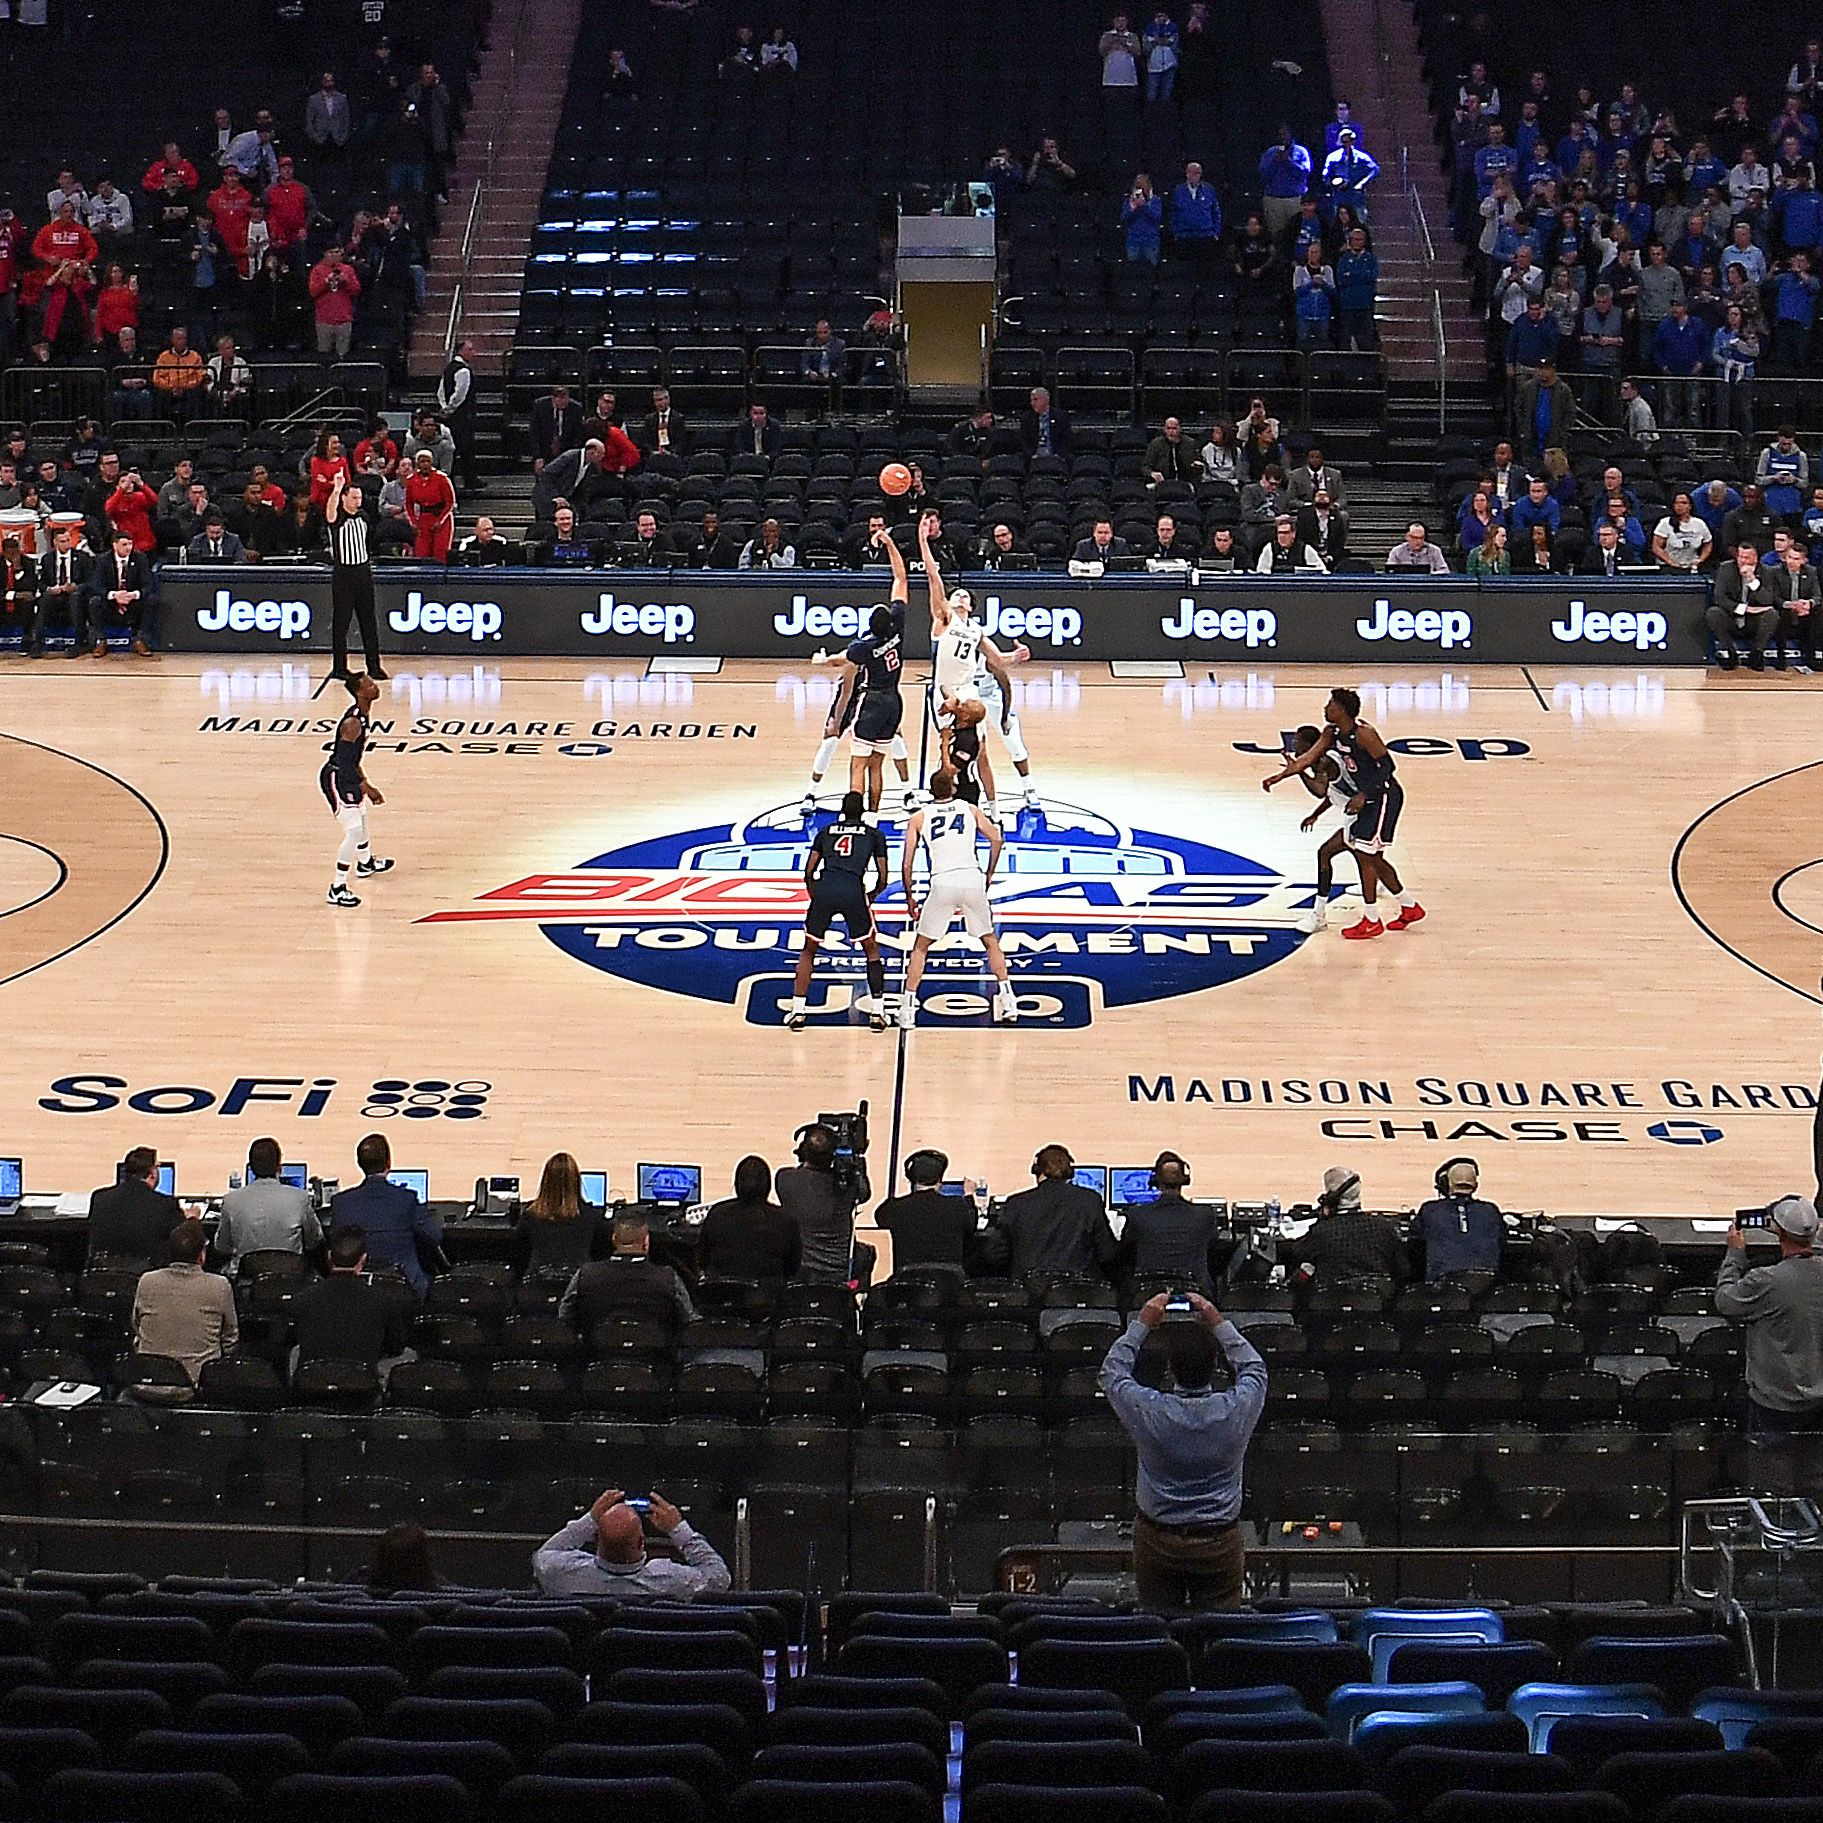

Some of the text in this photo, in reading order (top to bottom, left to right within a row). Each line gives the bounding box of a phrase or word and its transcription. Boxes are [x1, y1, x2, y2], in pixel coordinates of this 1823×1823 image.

[884, 649, 901, 672] 2
[953, 640, 972, 660] 13
[198, 716, 759, 739] MADISN SQUARE GARDEN
[1232, 730, 1533, 762] Jep
[930, 813, 965, 841] 24
[833, 835, 853, 857] 4
[473, 874, 813, 902] BIG
[37, 1074, 339, 1118] SoFi
[1127, 1074, 1394, 1105] MADISON
[1417, 1076, 1646, 1109] SQUARE
[1320, 1118, 1629, 1143] CHASE
[1008, 1573, 1037, 1593] 1-2
